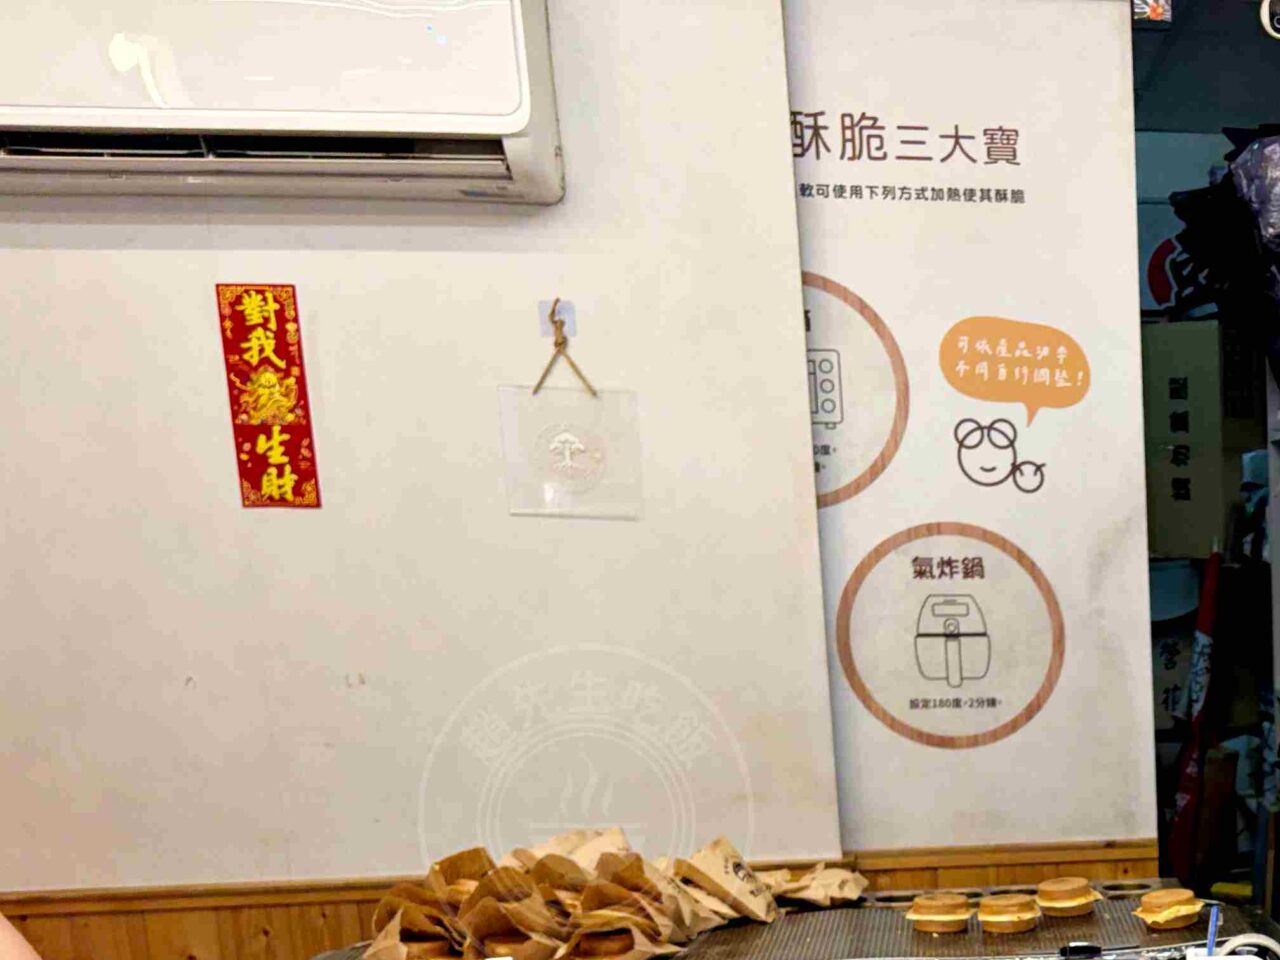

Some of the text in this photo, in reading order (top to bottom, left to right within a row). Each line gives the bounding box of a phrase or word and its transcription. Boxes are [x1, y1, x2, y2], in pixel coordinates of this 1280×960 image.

[790, 110, 1021, 166] 酥脆三大寶
[235, 290, 298, 501] 對我 生財
[912, 556, 985, 580] 氣炸鍋
